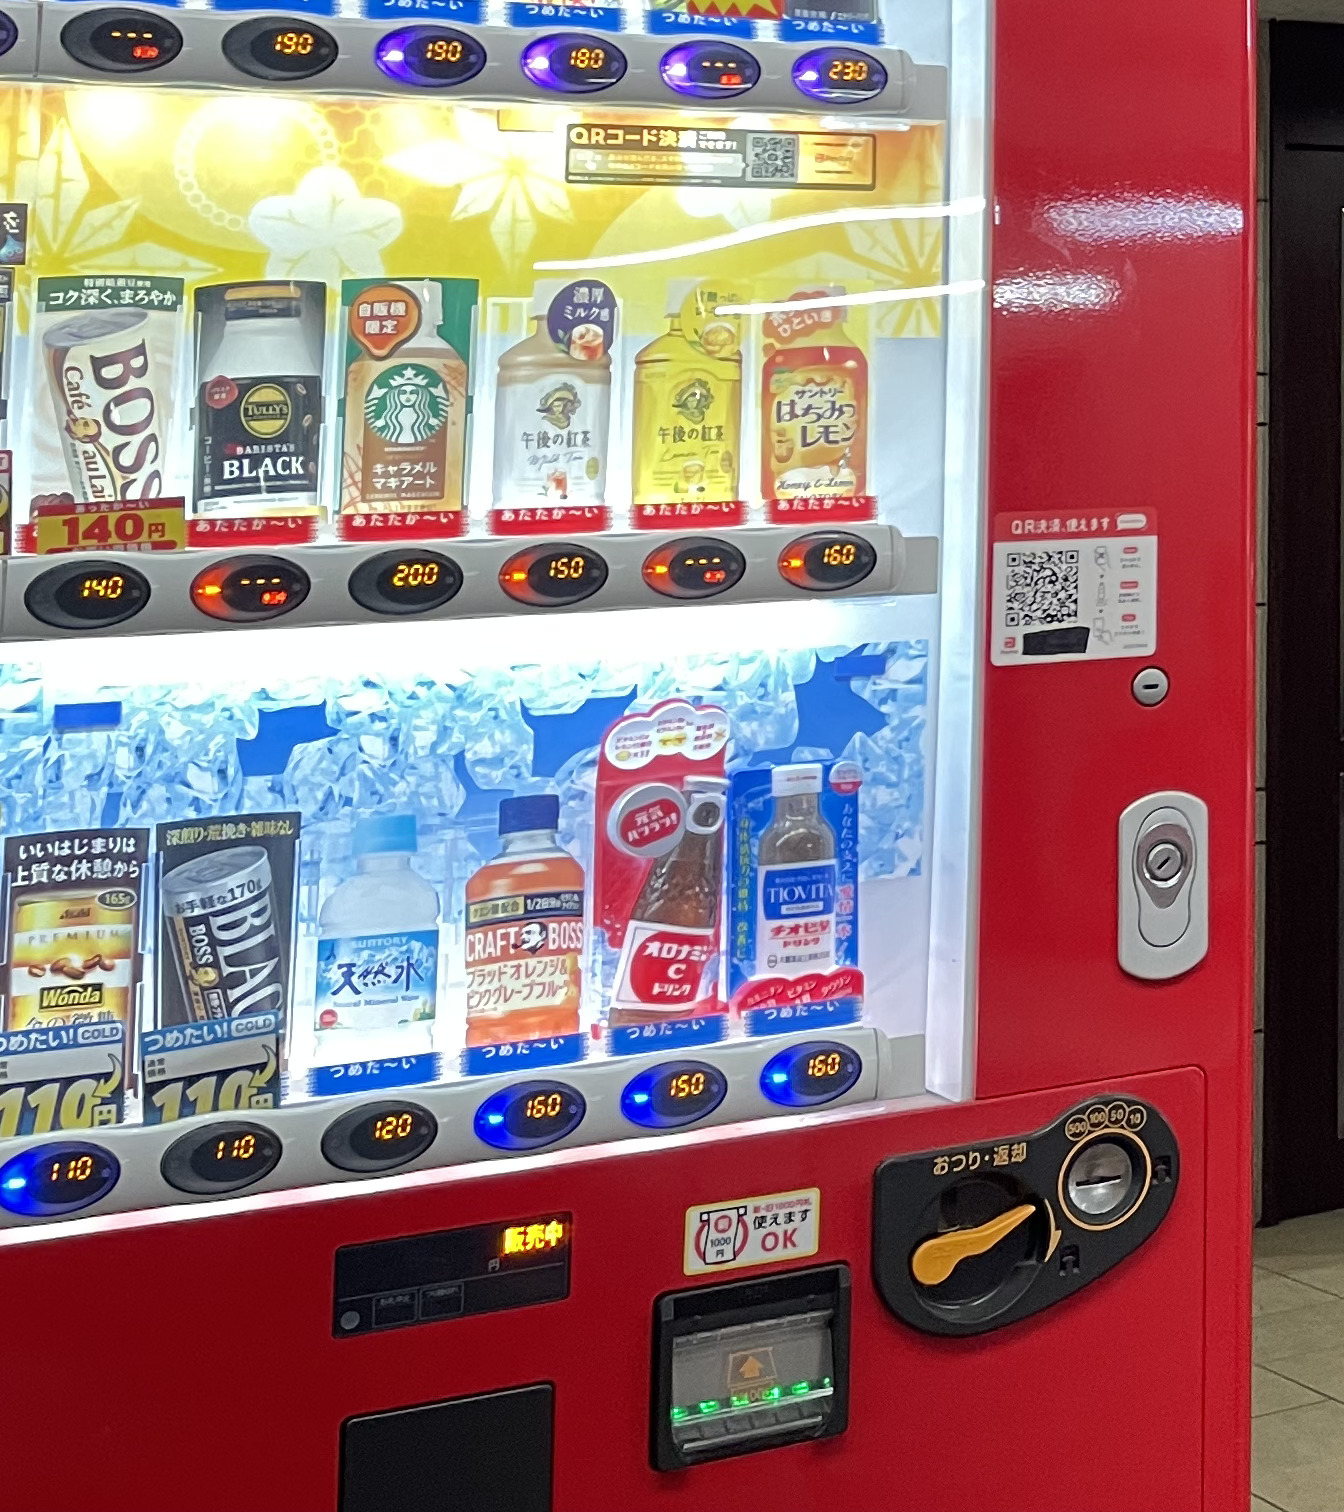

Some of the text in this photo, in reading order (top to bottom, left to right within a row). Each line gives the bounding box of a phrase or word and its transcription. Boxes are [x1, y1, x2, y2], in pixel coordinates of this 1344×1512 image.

[273, 32, 315, 55] 190
[425, 40, 463, 63] 190
[569, 49, 605, 69] 180
[827, 61, 868, 80] 230
[365, 320, 398, 335] 限定
[63, 366, 93, 410] Café
[776, 400, 857, 424] はちみつ
[520, 430, 592, 449] 午後の紅茶
[658, 425, 724, 444] 午後の紅茶
[801, 423, 857, 447] レモン
[222, 457, 305, 480] BLACK
[372, 462, 438, 475] キャラメル
[372, 477, 436, 490] マキアート
[62, 512, 166, 545] 140円
[823, 544, 855, 566] 160
[392, 563, 439, 586] 200
[549, 556, 585, 578] 150
[80, 576, 124, 598] 140
[634, 805, 664, 826] 元気
[19, 837, 137, 860] いいはじまりは
[11, 860, 140, 888] 上質な休憩から
[766, 883, 835, 904] TIOVITA
[28, 928, 122, 946] PREMIUM
[189, 923, 214, 965] BOSS
[465, 922, 585, 963] CRAFT BOSS
[330, 956, 425, 996] 天然水
[667, 963, 688, 979] C
[41, 985, 102, 1007] Wonda
[81, 1026, 120, 1041] COLD
[235, 1017, 273, 1032] COLD
[147, 1022, 229, 1052] つめたい!
[807, 1053, 841, 1078] 160
[669, 1074, 706, 1098] 150
[525, 1094, 561, 1118] 160
[374, 1114, 413, 1140] 120
[1068, 1119, 1088, 1135] 500
[1089, 1110, 1107, 1125] 100
[1109, 1108, 1125, 1122] 50
[216, 1135, 256, 1160] 110
[933, 1141, 1028, 1176] おつり・返却
[50, 1156, 93, 1182] 110
[753, 1208, 812, 1231] 使えます
[503, 1219, 564, 1255] 販売中
[710, 1236, 732, 1248] 1000
[760, 1227, 799, 1253] OK
